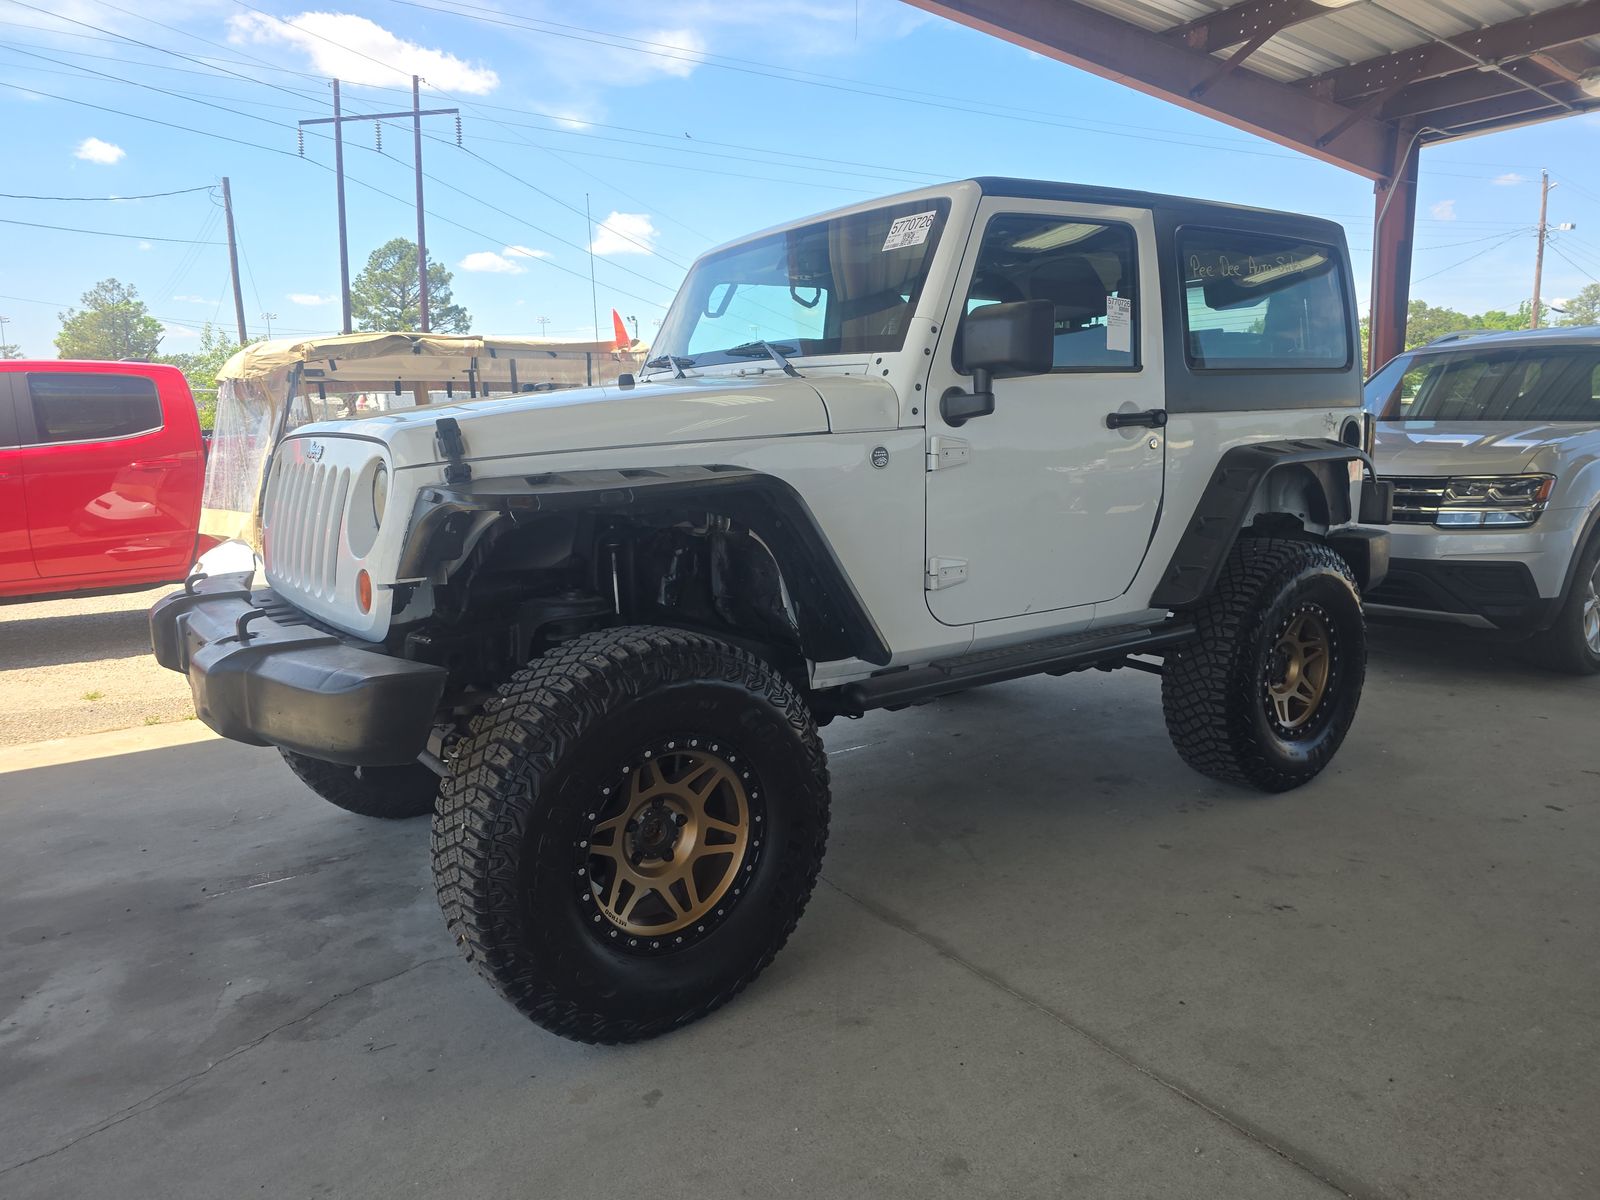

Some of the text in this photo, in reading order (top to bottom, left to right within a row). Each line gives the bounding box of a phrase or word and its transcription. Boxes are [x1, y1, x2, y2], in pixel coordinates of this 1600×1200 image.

[891, 214, 935, 235] 5770726
[1190, 254, 1214, 278] Pee
[1219, 255, 1242, 277] Dee
